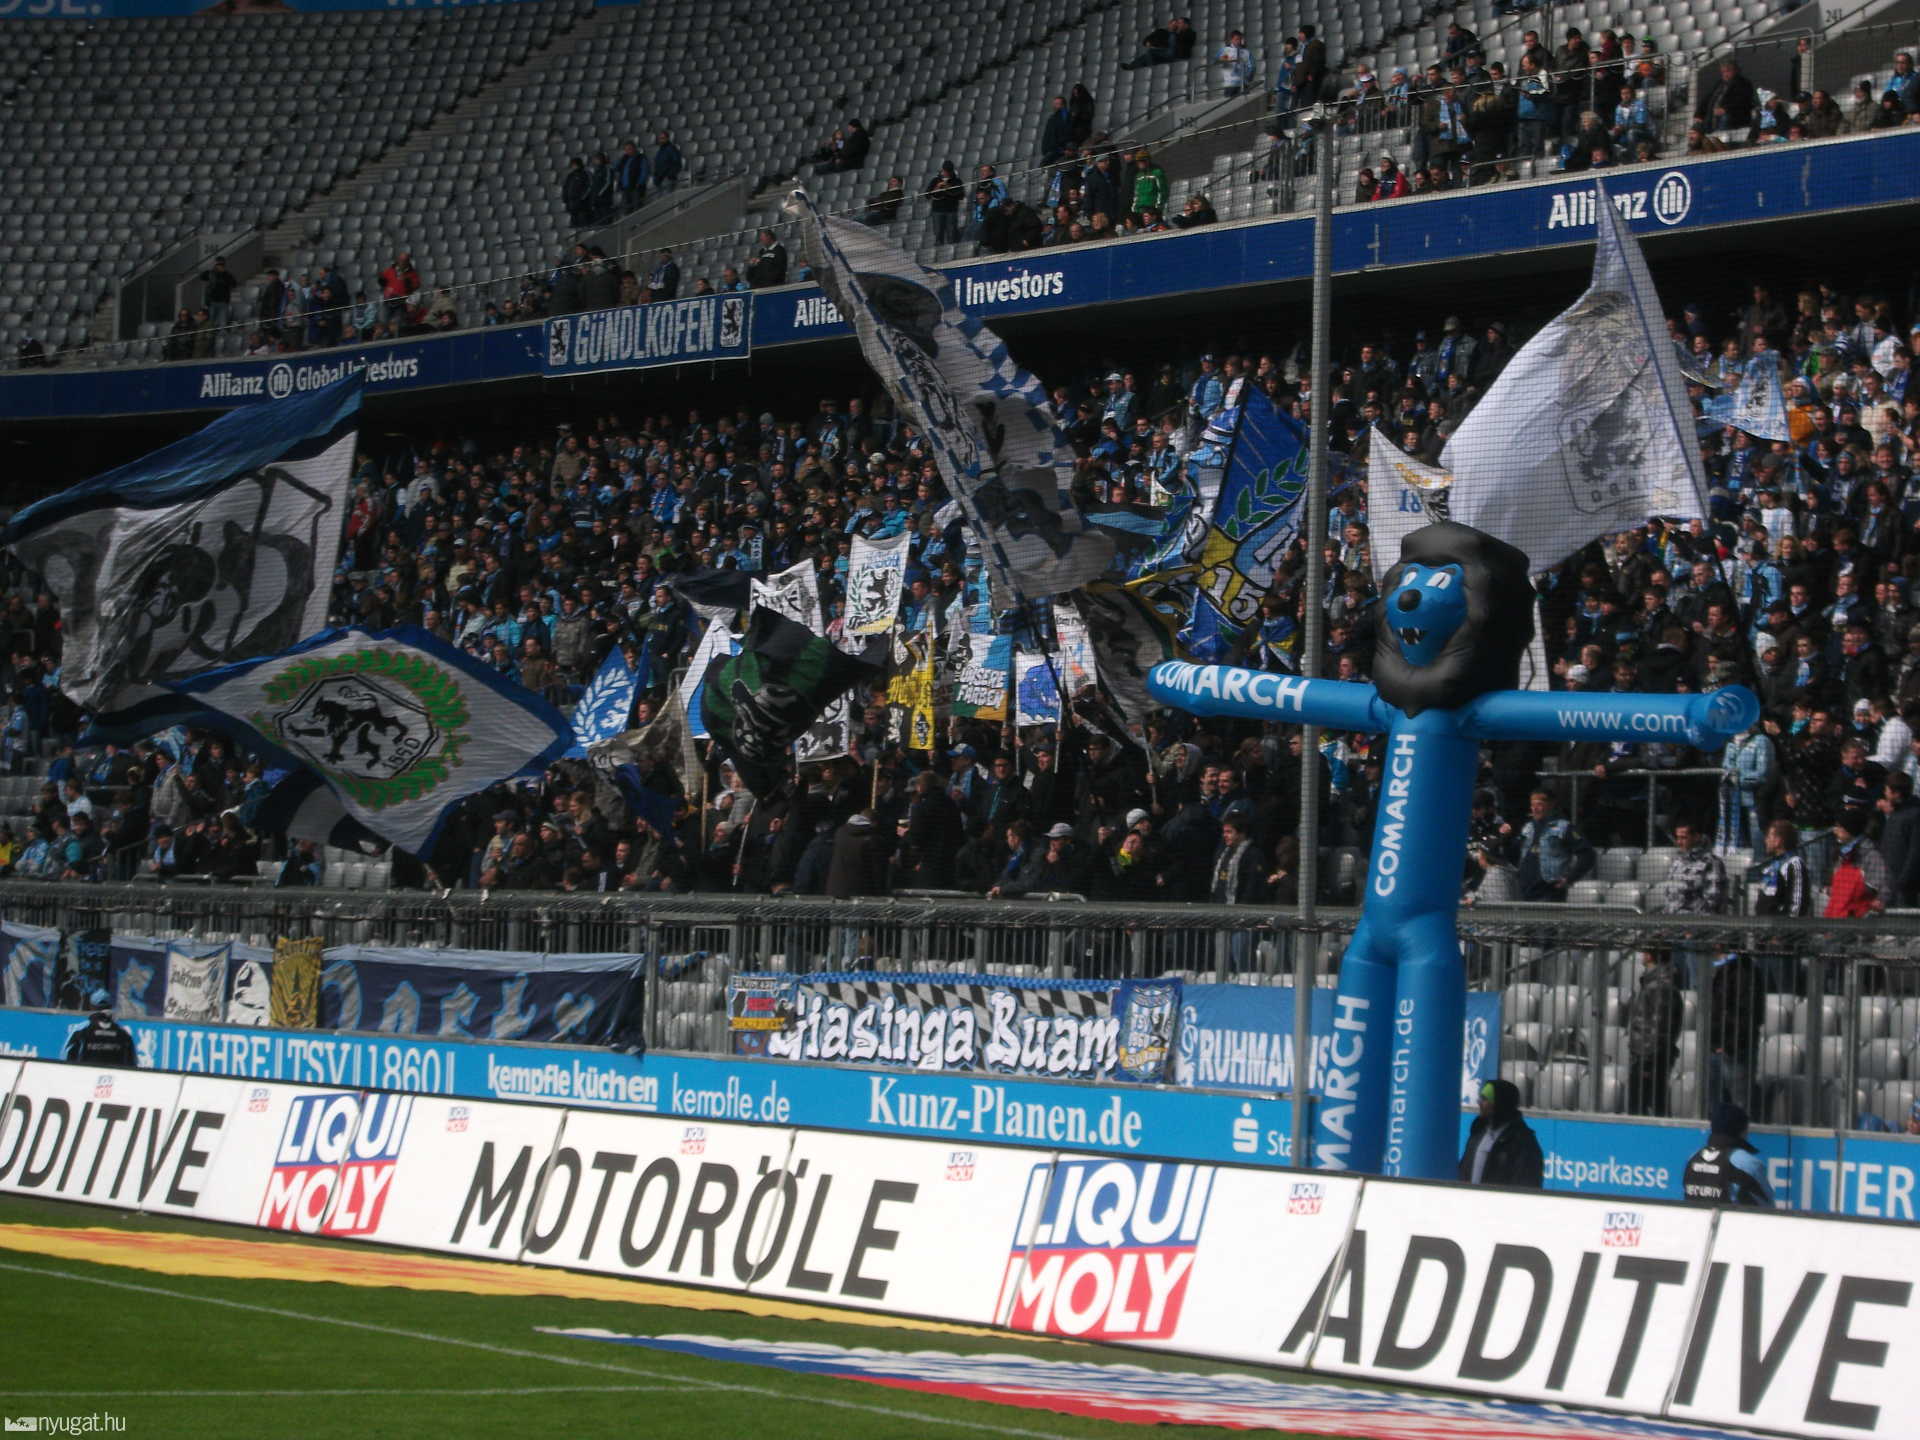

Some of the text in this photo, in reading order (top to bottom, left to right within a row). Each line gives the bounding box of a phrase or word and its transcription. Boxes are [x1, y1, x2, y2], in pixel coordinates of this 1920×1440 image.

[1548, 189, 1647, 229] Allinz
[574, 298, 715, 364] GÜNDLKOFEN
[793, 297, 843, 328] Allia
[965, 269, 1063, 305] Investors
[200, 372, 264, 398] Allianz
[296, 361, 344, 391] Global
[1156, 661, 1310, 711] COMARCH
[1375, 733, 1417, 896] COMARCH
[177, 1030, 442, 1093] JAHRE TSV 1860
[986, 991, 1120, 1072] Buam
[277, 1093, 415, 1164] LIQUI
[671, 1072, 790, 1122] kempfle.de
[867, 1075, 1142, 1148] Kunz-Planen.de
[0, 1092, 225, 1207] DDITIVE
[1543, 1151, 1669, 1189] dtsparkasse
[259, 1166, 396, 1234] MOLY
[451, 1141, 919, 1299] MOTORÖLE
[1015, 1162, 1216, 1249] LIQUI
[1603, 1212, 1643, 1229] LIQUI
[1767, 1157, 1915, 1219] EITER
[1600, 1229, 1641, 1247] MOLY
[996, 1251, 1196, 1335] MOLY
[1280, 1229, 1913, 1430] ADDITIVE
